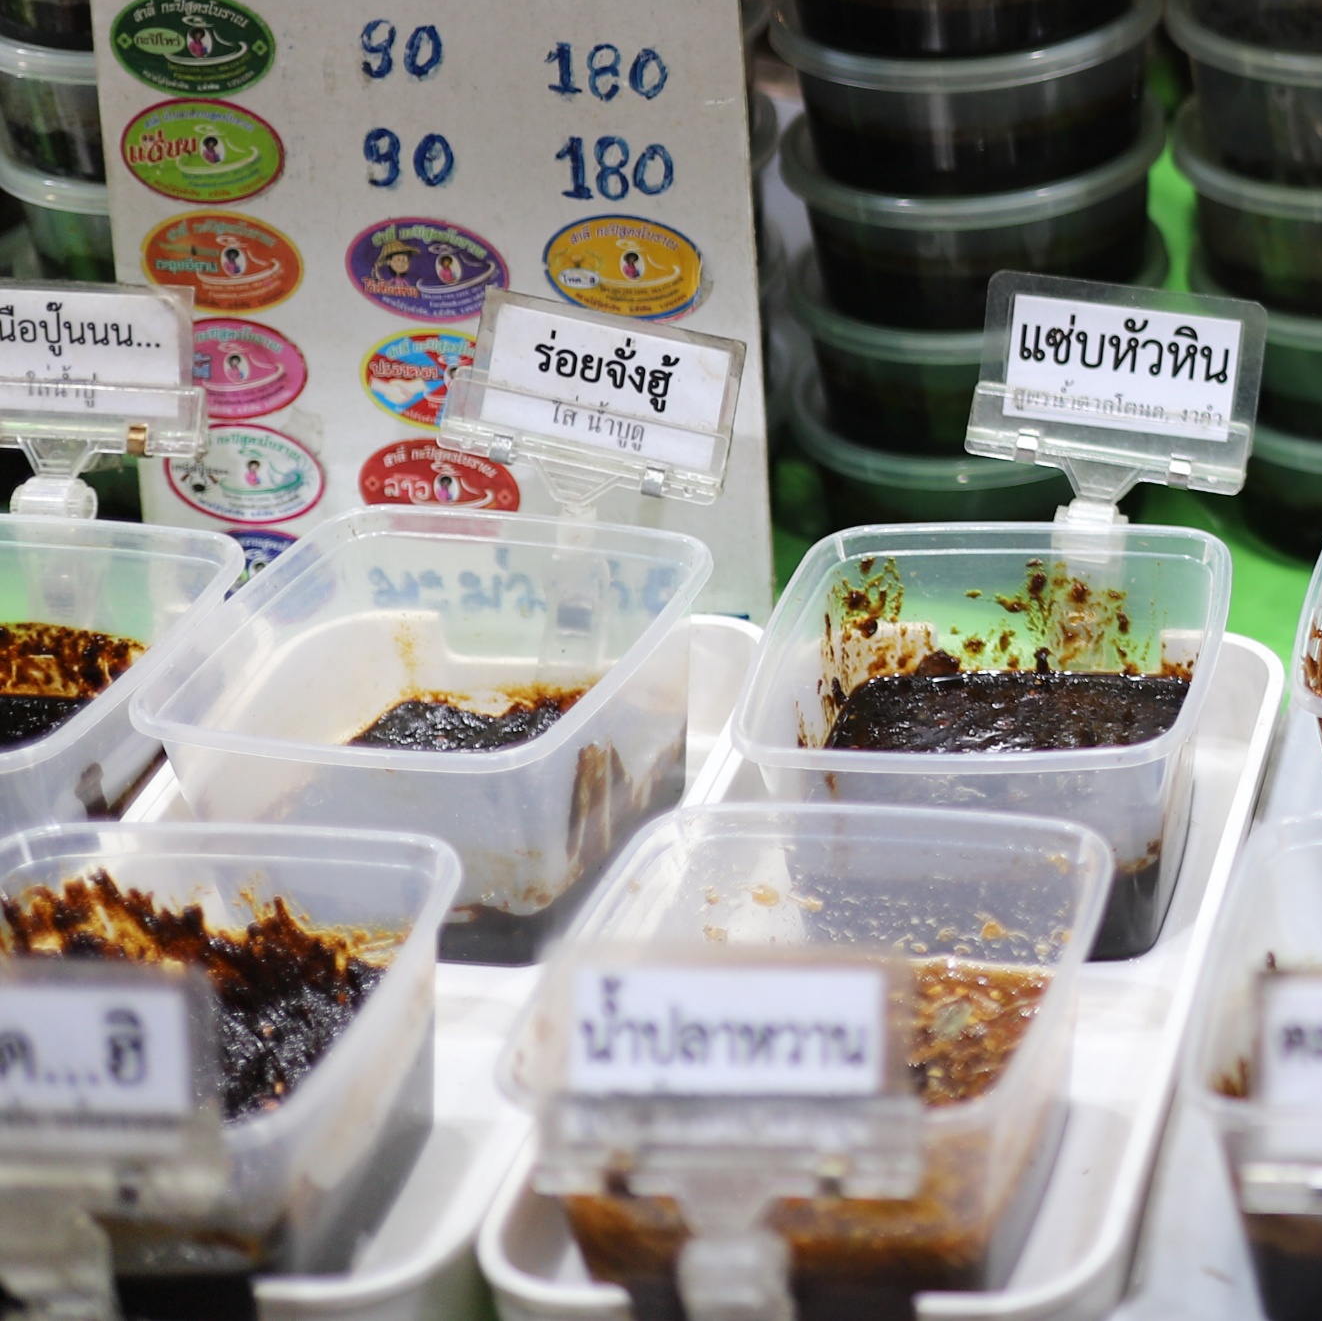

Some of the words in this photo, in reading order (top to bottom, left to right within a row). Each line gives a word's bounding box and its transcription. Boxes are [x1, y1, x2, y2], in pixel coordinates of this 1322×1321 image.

[360, 18, 443, 80] 90
[544, 41, 668, 101] 180
[363, 127, 455, 188] 90
[555, 135, 675, 201] 180
[534, 331, 680, 413] ร่อยจั่งฮู้
[1019, 315, 1230, 384] แซ่บหัวหิน
[384, 478, 431, 501] ลาว
[580, 976, 868, 1065] น้ำปลาหวาน
